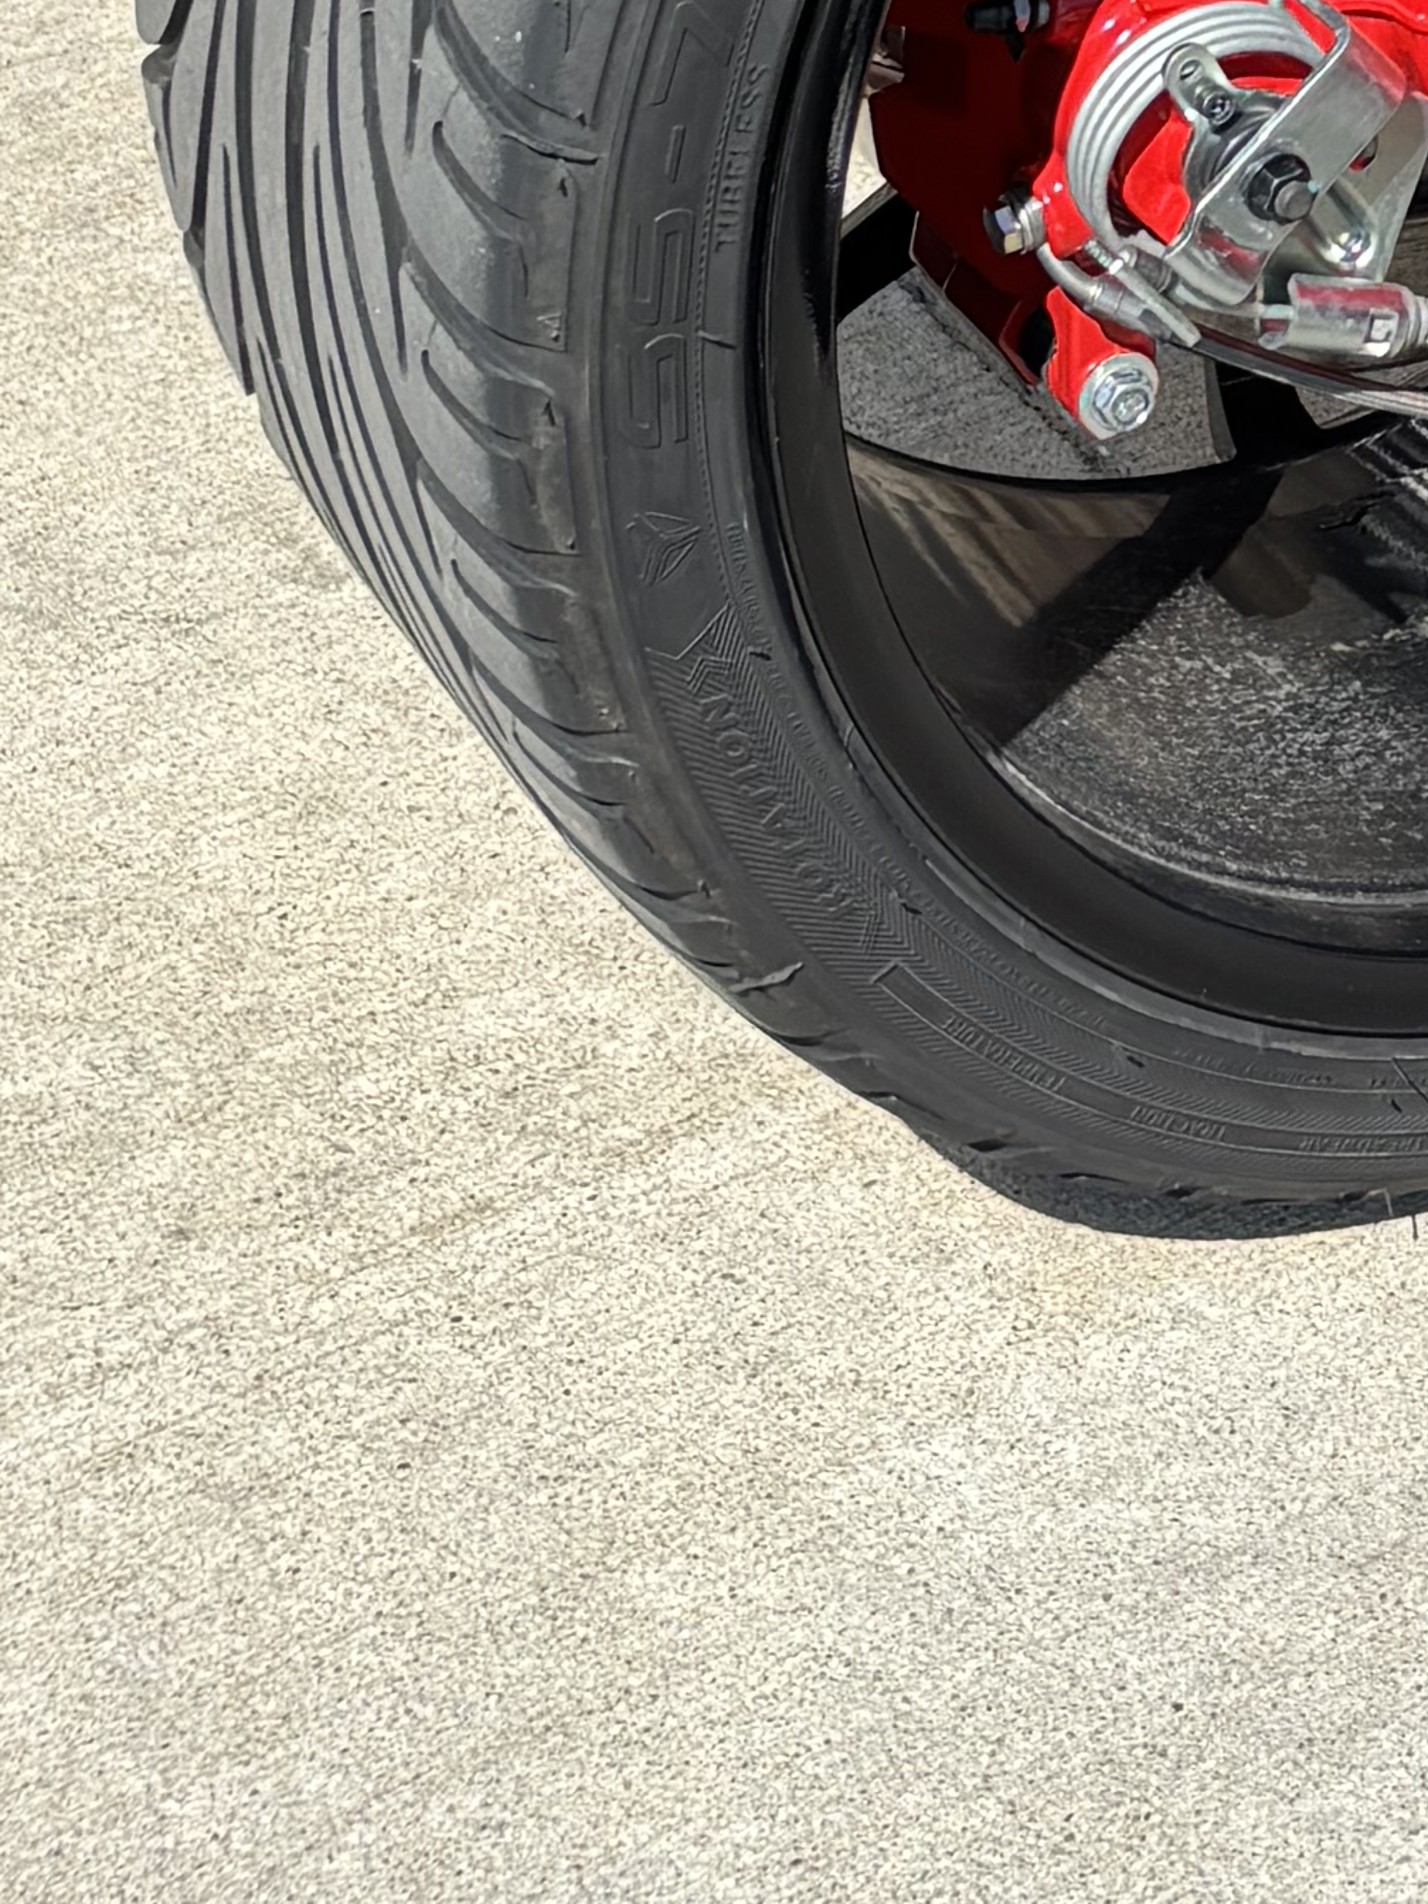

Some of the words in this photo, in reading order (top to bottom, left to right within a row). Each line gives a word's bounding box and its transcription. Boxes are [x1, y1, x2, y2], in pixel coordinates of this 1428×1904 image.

[714, 63, 769, 253] TUBELESS
[700, 693, 857, 919] ROTATION
[1131, 1106, 1229, 1141] TRACTION
